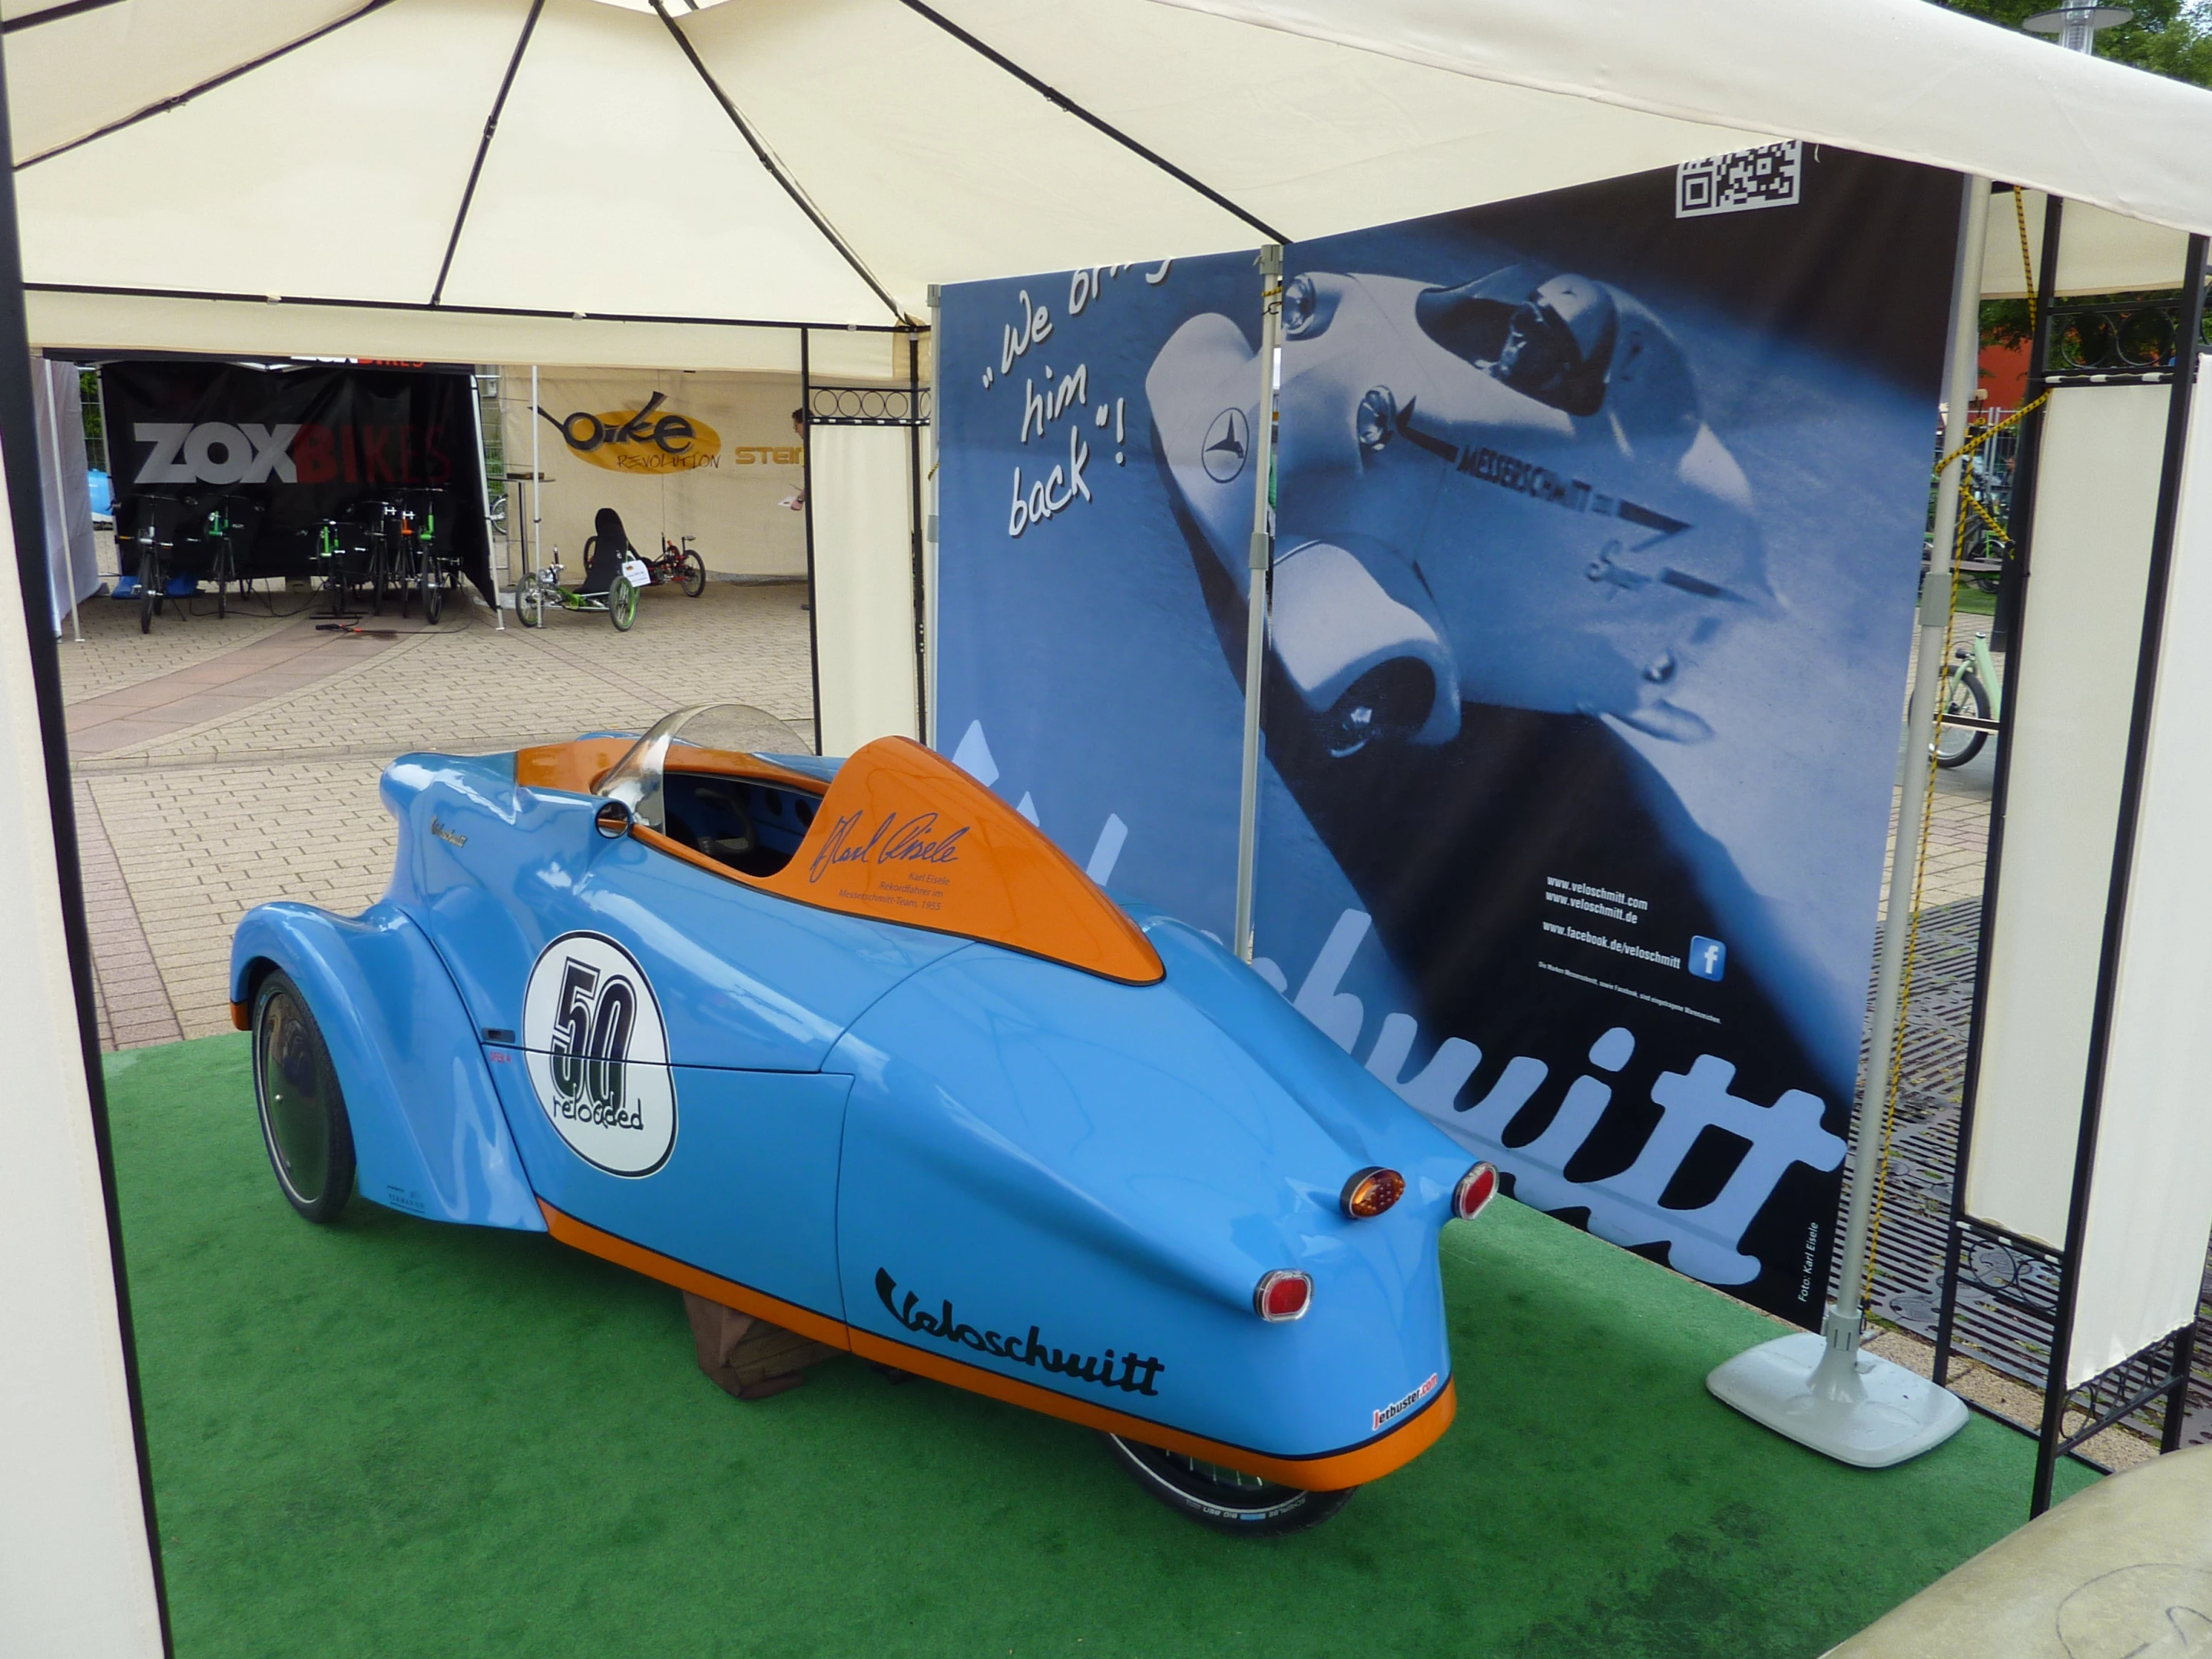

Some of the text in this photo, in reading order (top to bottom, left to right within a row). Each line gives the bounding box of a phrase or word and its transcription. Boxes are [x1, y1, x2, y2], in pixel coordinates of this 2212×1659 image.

[1021, 363, 1087, 442] him
[617, 454, 721, 469] REVOLUTION
[879, 881, 943, 898] Rekordfahrer im
[909, 871, 950, 886] Karl Eisele
[1546, 876, 1648, 911] www.veloschmitt.com
[838, 889, 942, 911] Messerschmitt-Team, 1955
[1545, 890, 1638, 925] www.veloschmitt.de
[1541, 921, 1681, 969] www.facebook.de/veloschmitt
[1704, 945, 1720, 975] f
[550, 955, 637, 1108] 50
[553, 1083, 644, 1131] reloaded
[1797, 1222, 1819, 1303] Foto: Karl Eisele
[875, 1267, 1165, 1396] Veloschmitt
[1373, 1373, 1438, 1429] Jetbuster.com
